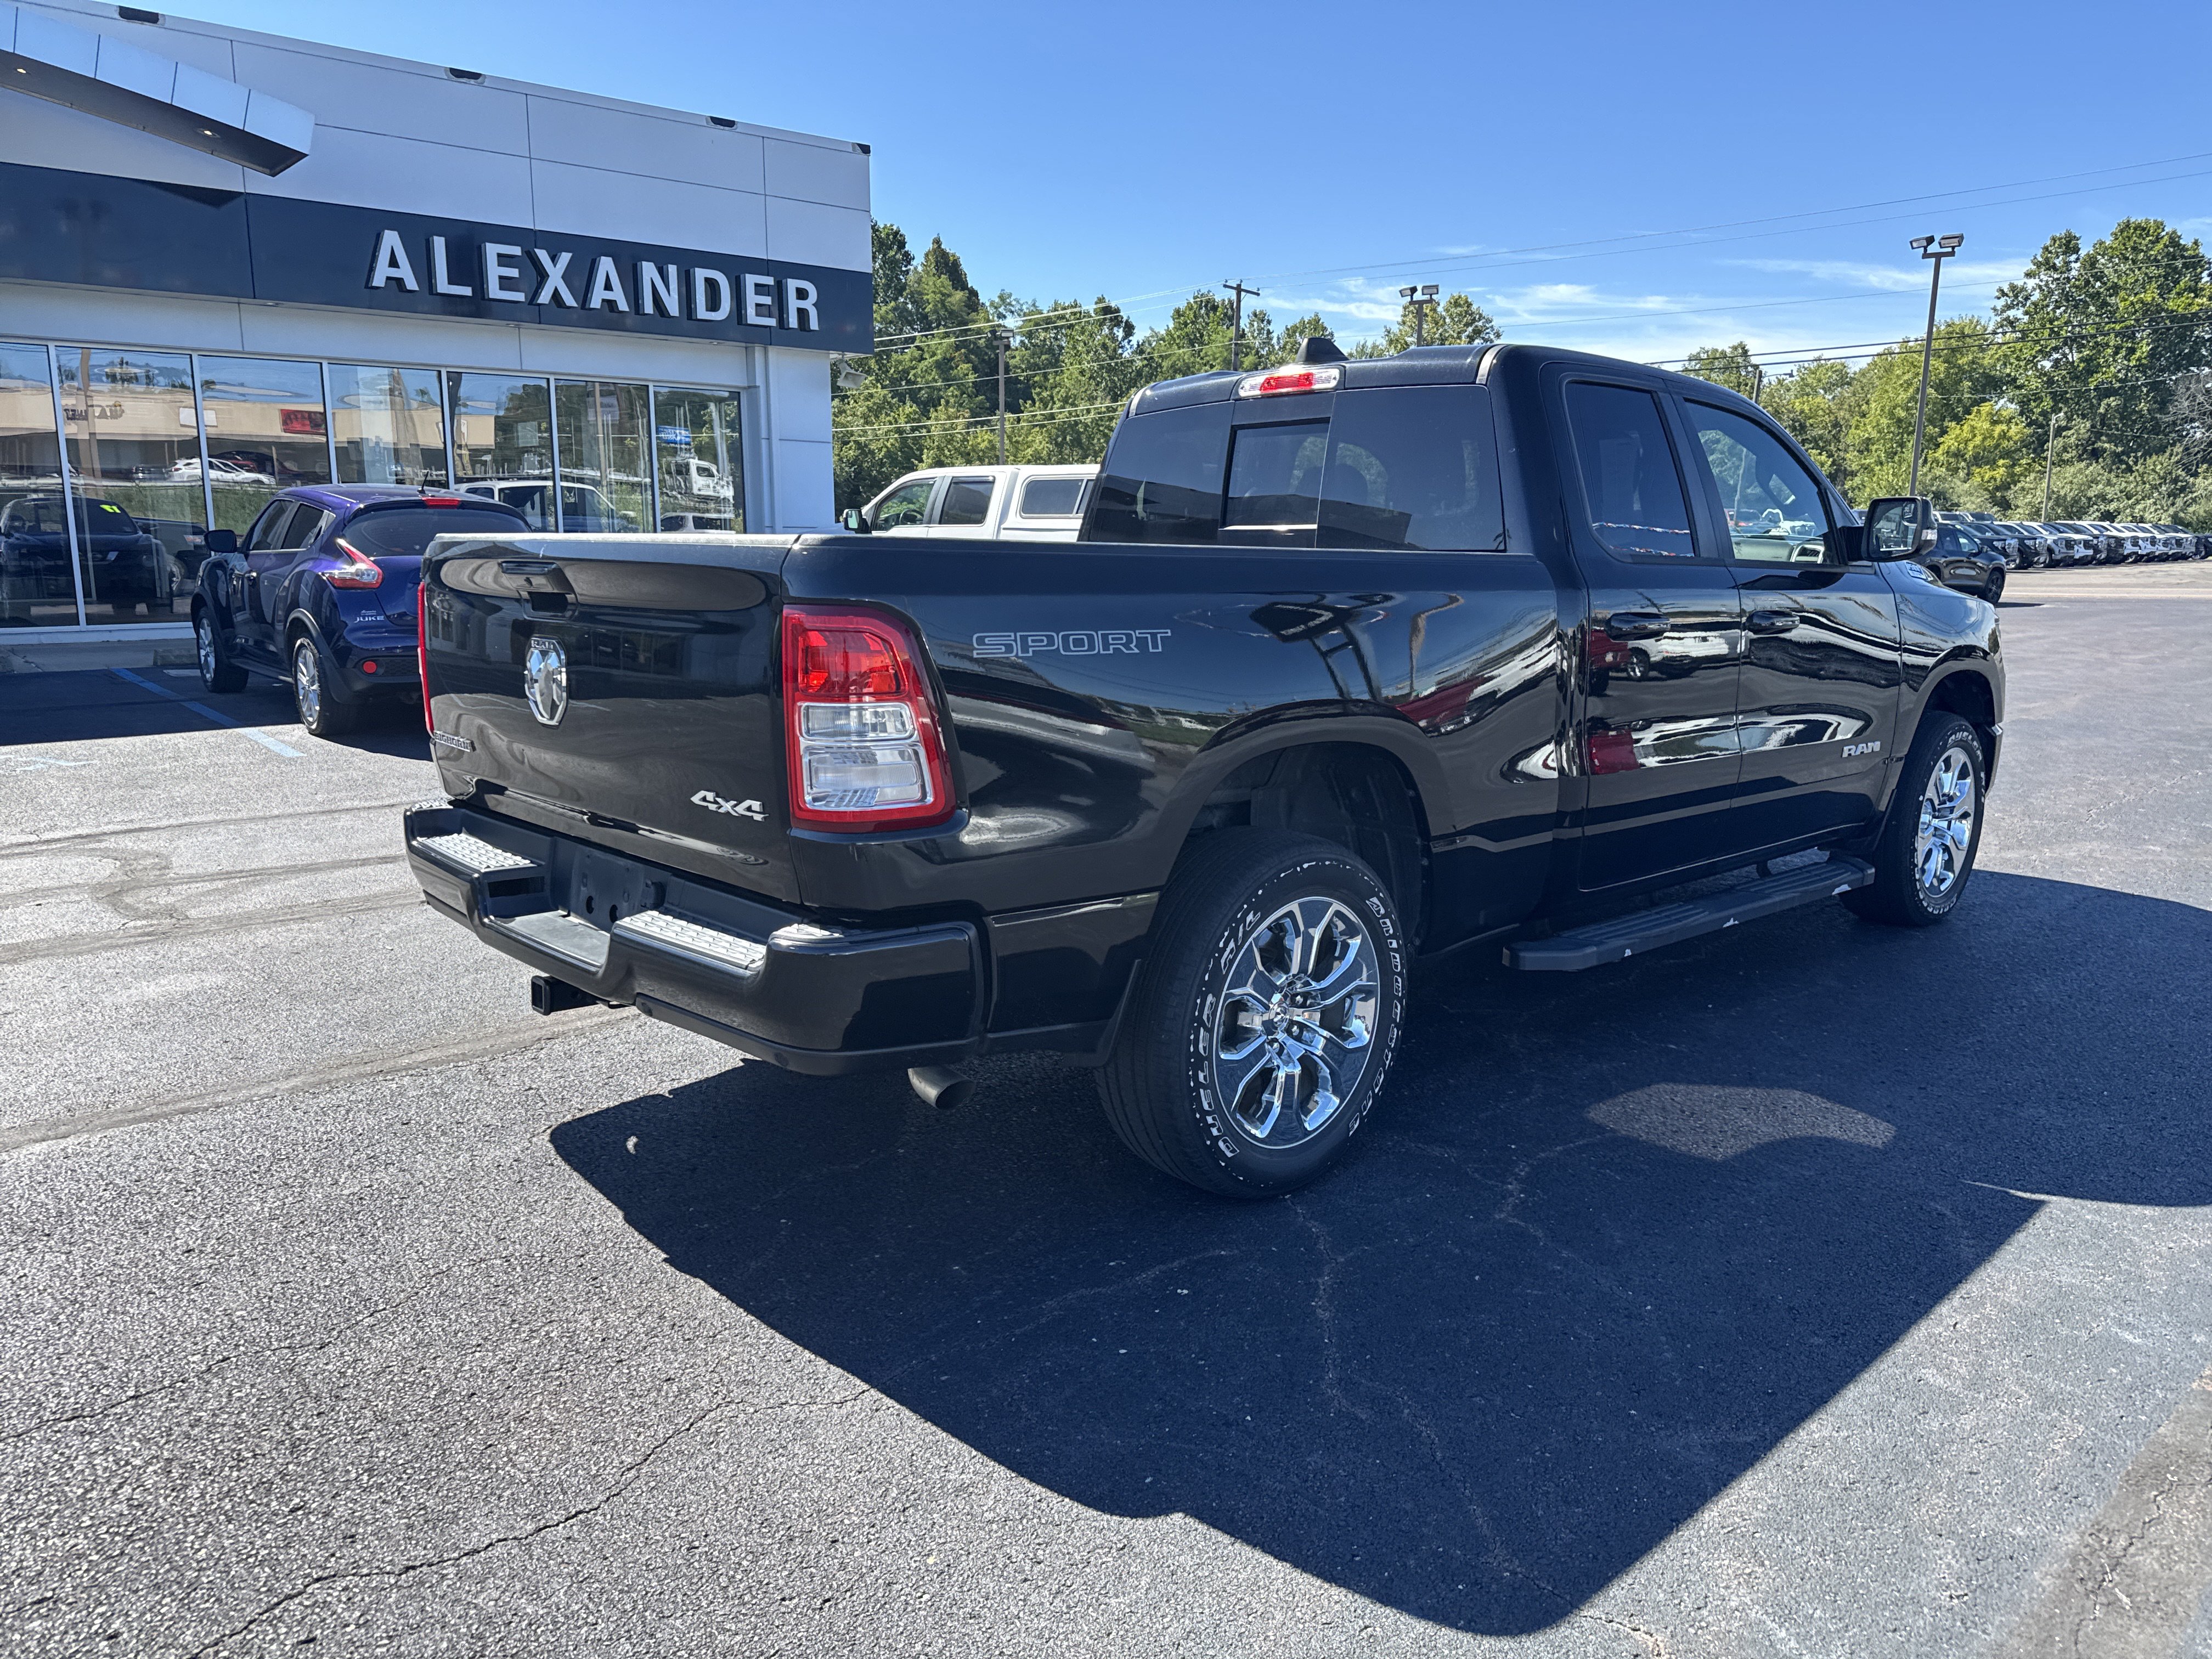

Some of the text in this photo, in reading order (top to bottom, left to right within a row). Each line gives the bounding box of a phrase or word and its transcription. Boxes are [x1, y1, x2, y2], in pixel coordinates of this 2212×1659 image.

[368, 229, 820, 331] ALEXANDER
[354, 615, 385, 623] JUKE
[531, 639, 554, 650] RAM
[973, 629, 1171, 658] SPORT
[1841, 741, 1881, 758] RAM
[1348, 896, 1402, 1137] BRIDGESTONE
